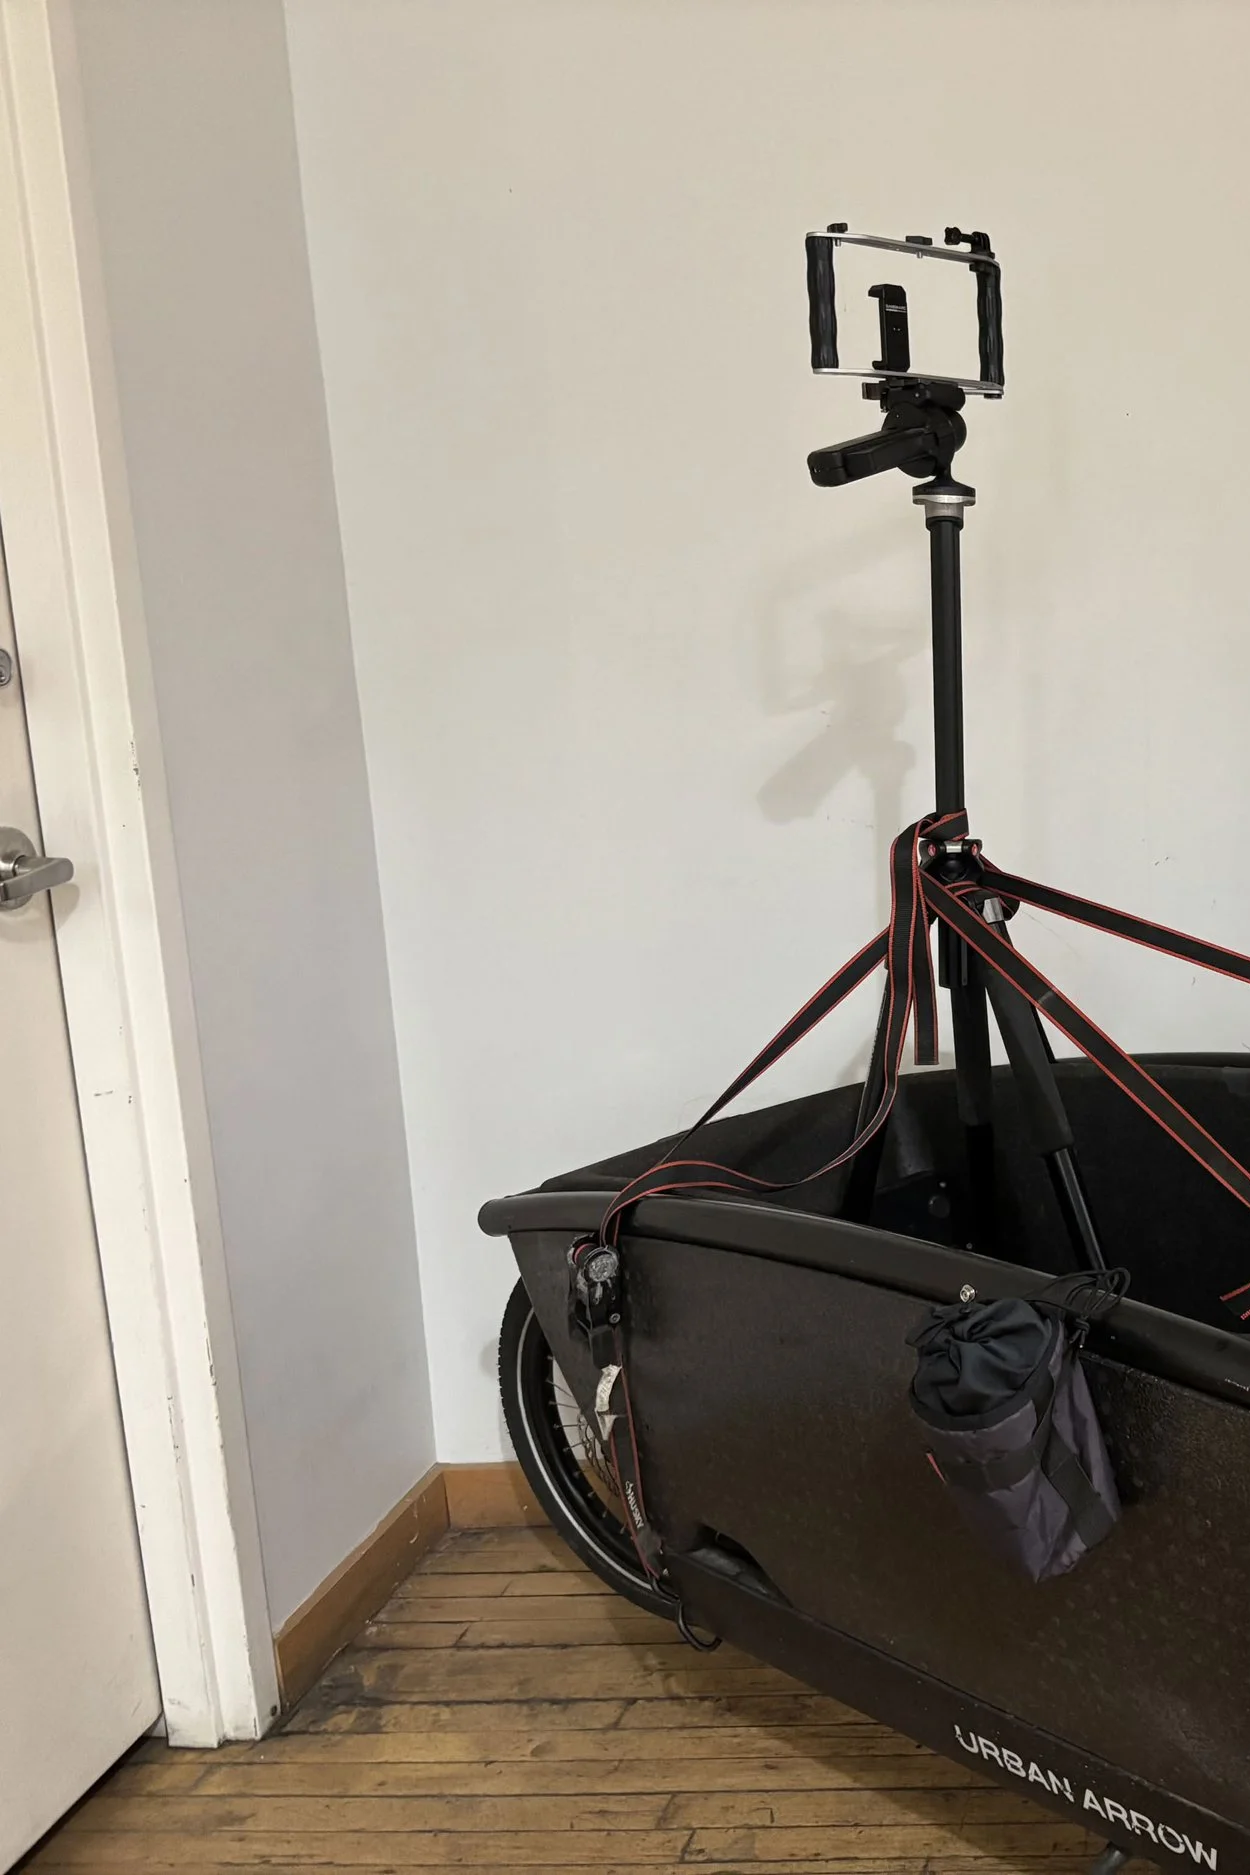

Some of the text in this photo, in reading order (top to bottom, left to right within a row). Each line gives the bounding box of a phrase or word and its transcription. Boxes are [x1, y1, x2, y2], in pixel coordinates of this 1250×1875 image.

[627, 1490, 645, 1529] HUSKY
[953, 1724, 1218, 1872] URBAN ARROW
